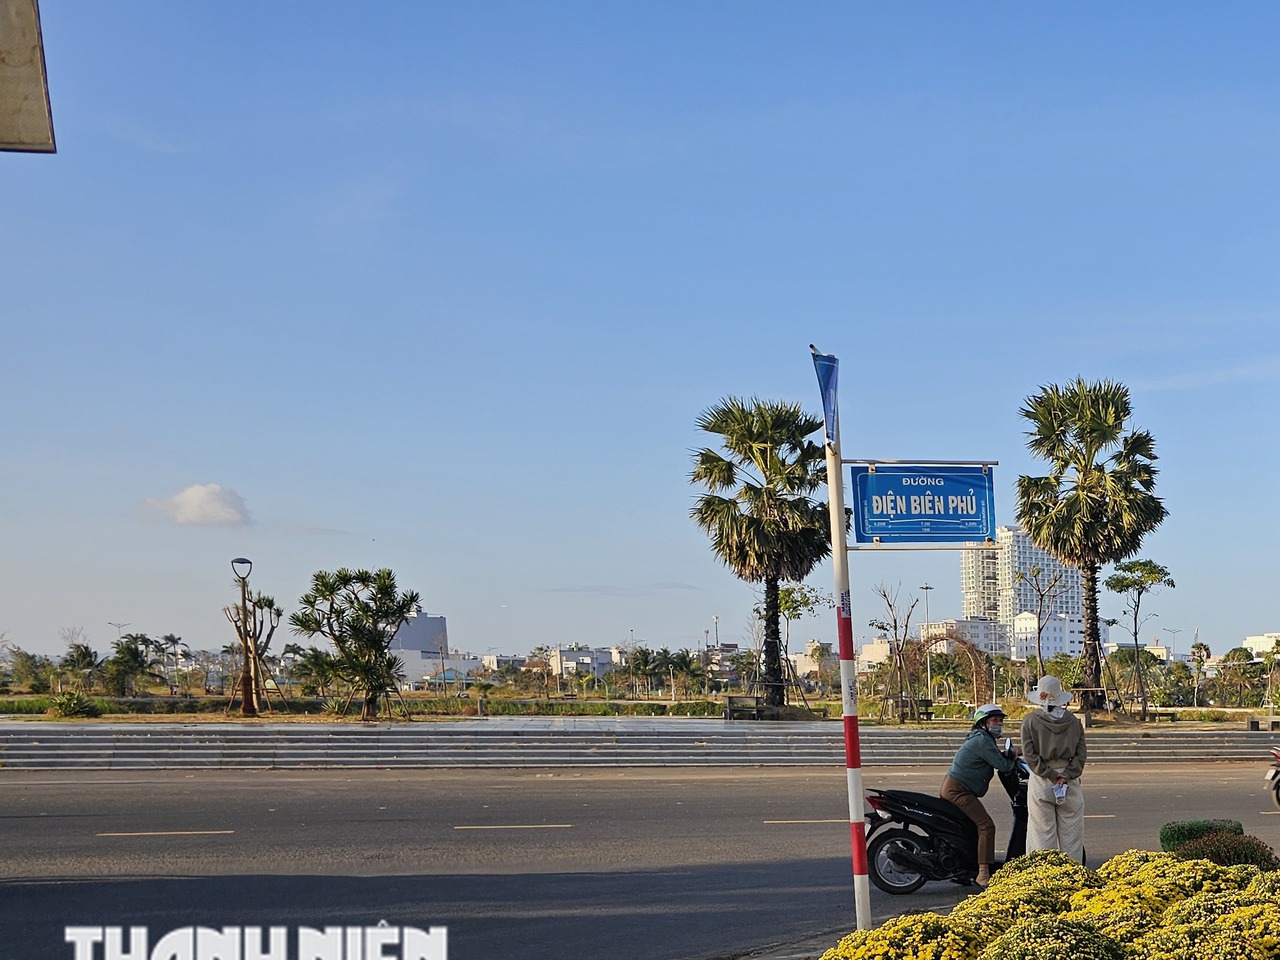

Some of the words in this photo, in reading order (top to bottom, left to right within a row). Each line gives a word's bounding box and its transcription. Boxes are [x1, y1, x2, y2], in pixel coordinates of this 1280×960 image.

[902, 476, 944, 486] ĐƯỜNG
[872, 490, 906, 518] ĐIỆN
[910, 490, 944, 515] BIÊN
[948, 488, 977, 515] PHỦ
